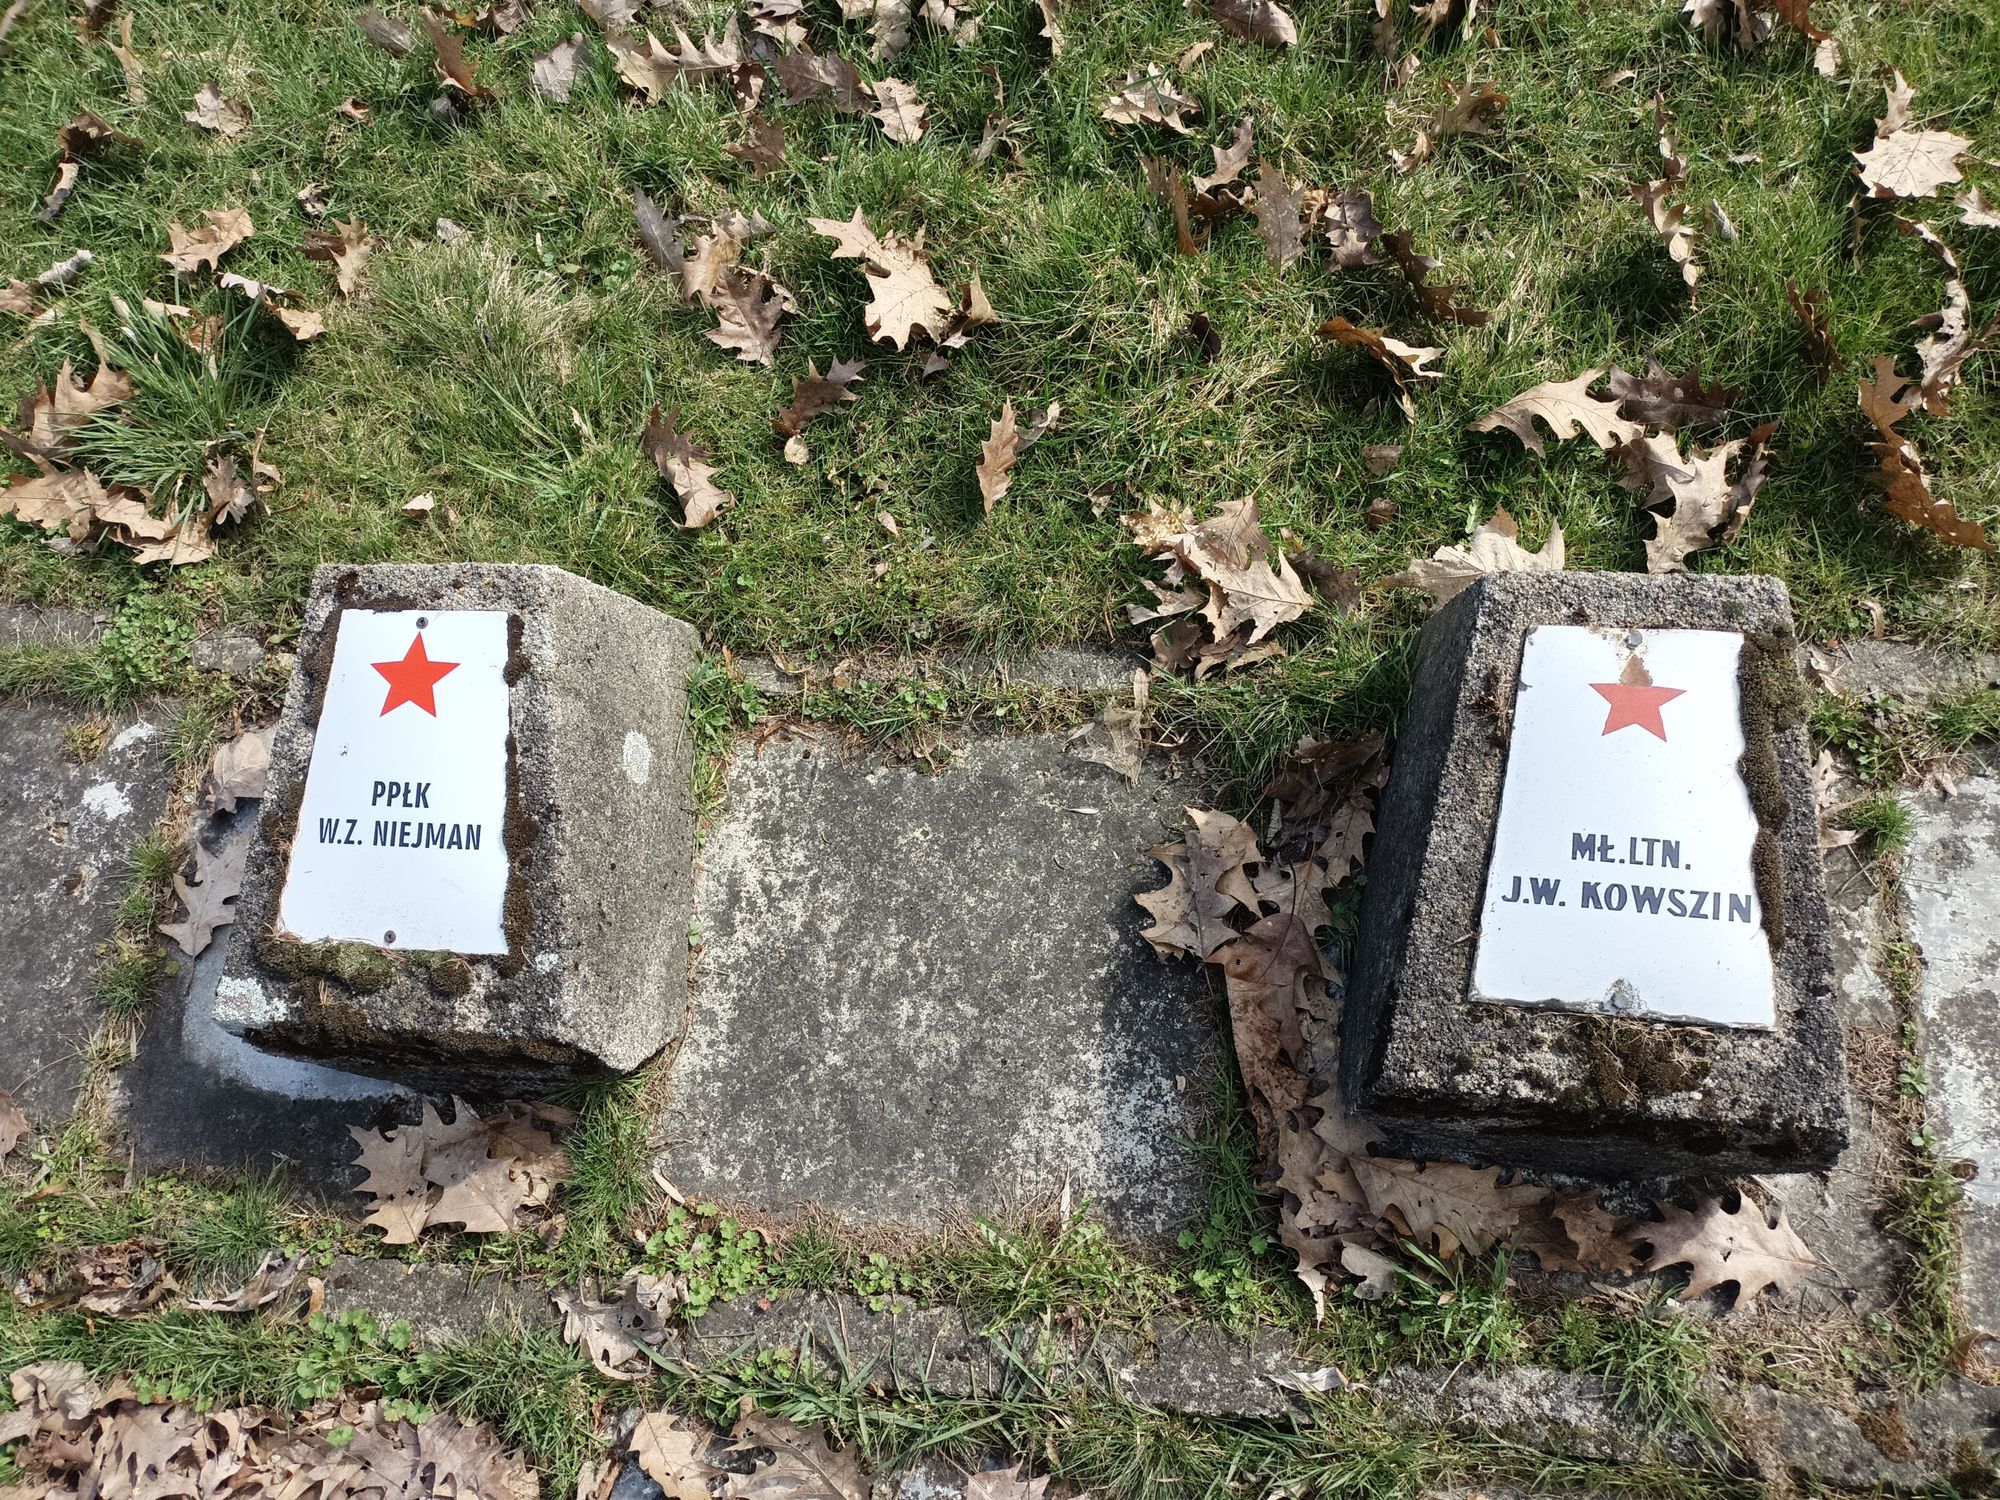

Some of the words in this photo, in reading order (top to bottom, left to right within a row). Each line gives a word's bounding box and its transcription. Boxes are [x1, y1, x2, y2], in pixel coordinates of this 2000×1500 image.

[371, 780, 431, 809] PPŁK
[319, 817, 363, 846] W.Z.
[372, 820, 482, 851] NIEJMAN
[1501, 875, 1567, 907] J.W.
[1580, 881, 1753, 924] KOWSZIN
